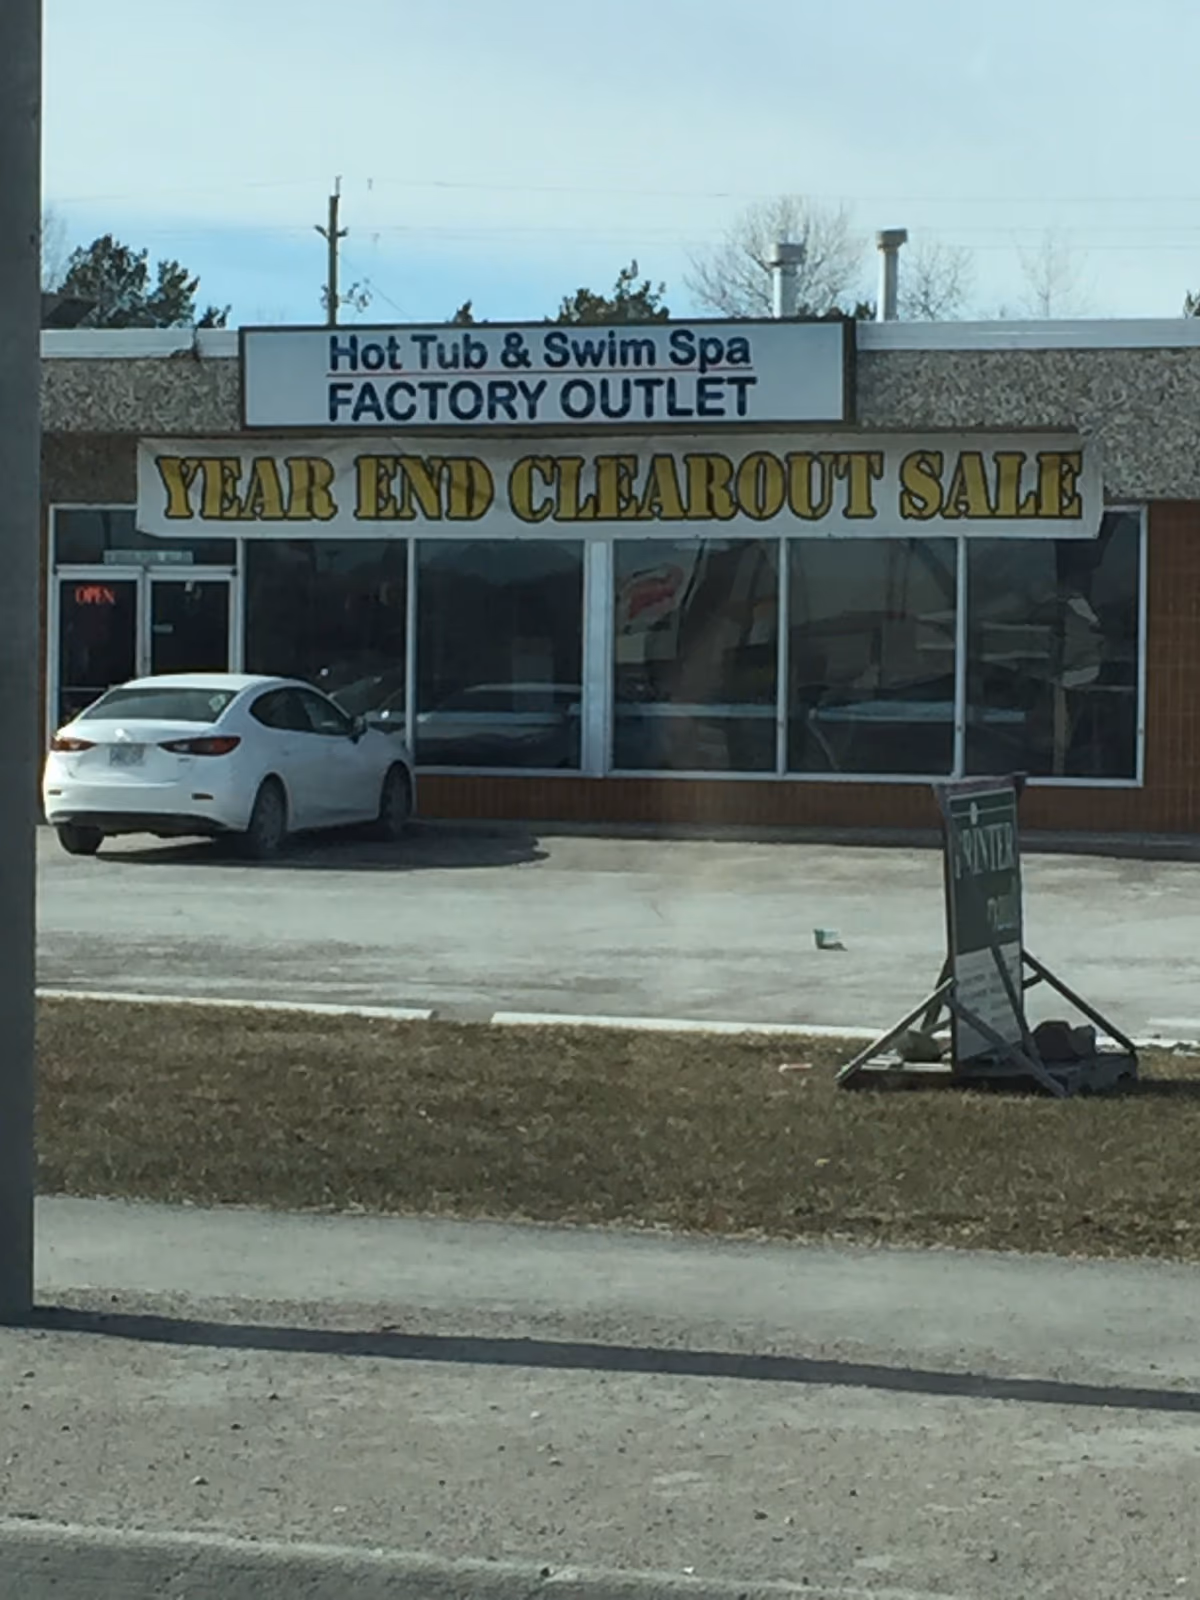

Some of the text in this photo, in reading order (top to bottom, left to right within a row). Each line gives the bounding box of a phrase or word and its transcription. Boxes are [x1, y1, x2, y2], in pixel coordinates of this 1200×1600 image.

[329, 329, 751, 374] Hot Tub & Swim Spa
[328, 376, 756, 421] FACTORY OUTLET
[155, 450, 1084, 523] YEAR END CLEAROUT SALE
[75, 586, 116, 606] OPEN
